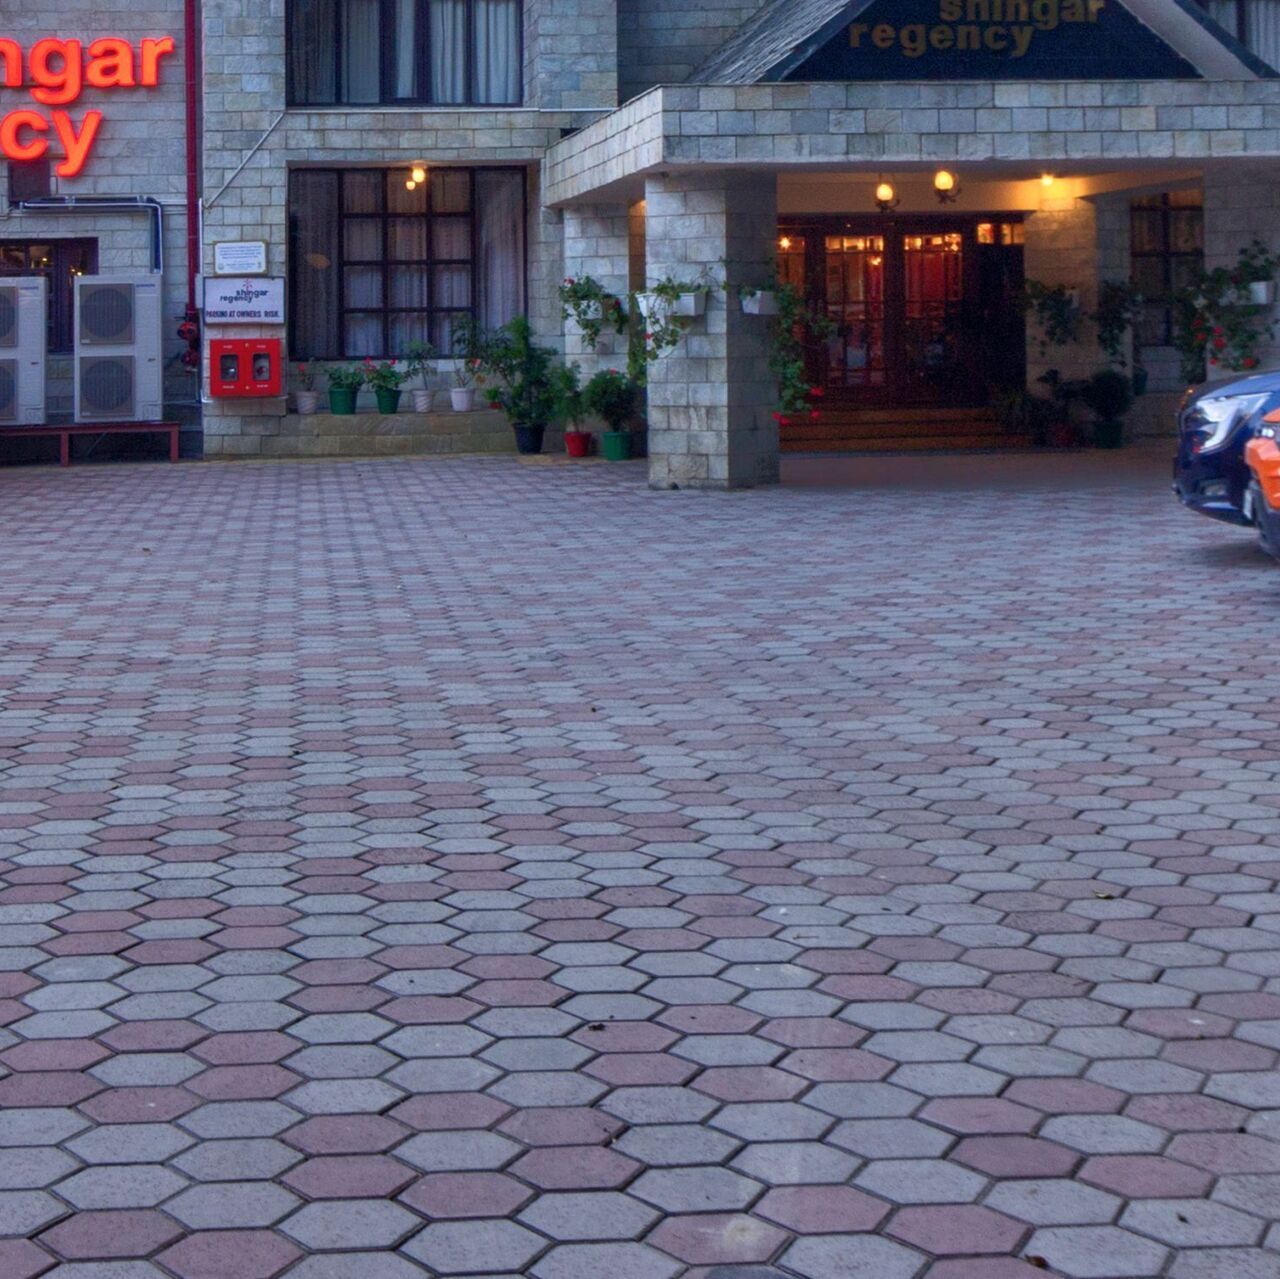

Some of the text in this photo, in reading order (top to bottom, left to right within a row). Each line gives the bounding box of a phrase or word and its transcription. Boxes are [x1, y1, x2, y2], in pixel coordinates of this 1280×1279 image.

[849, 23, 1034, 58] regency
[220, 295, 253, 303] regency
[236, 289, 268, 299] shingar
